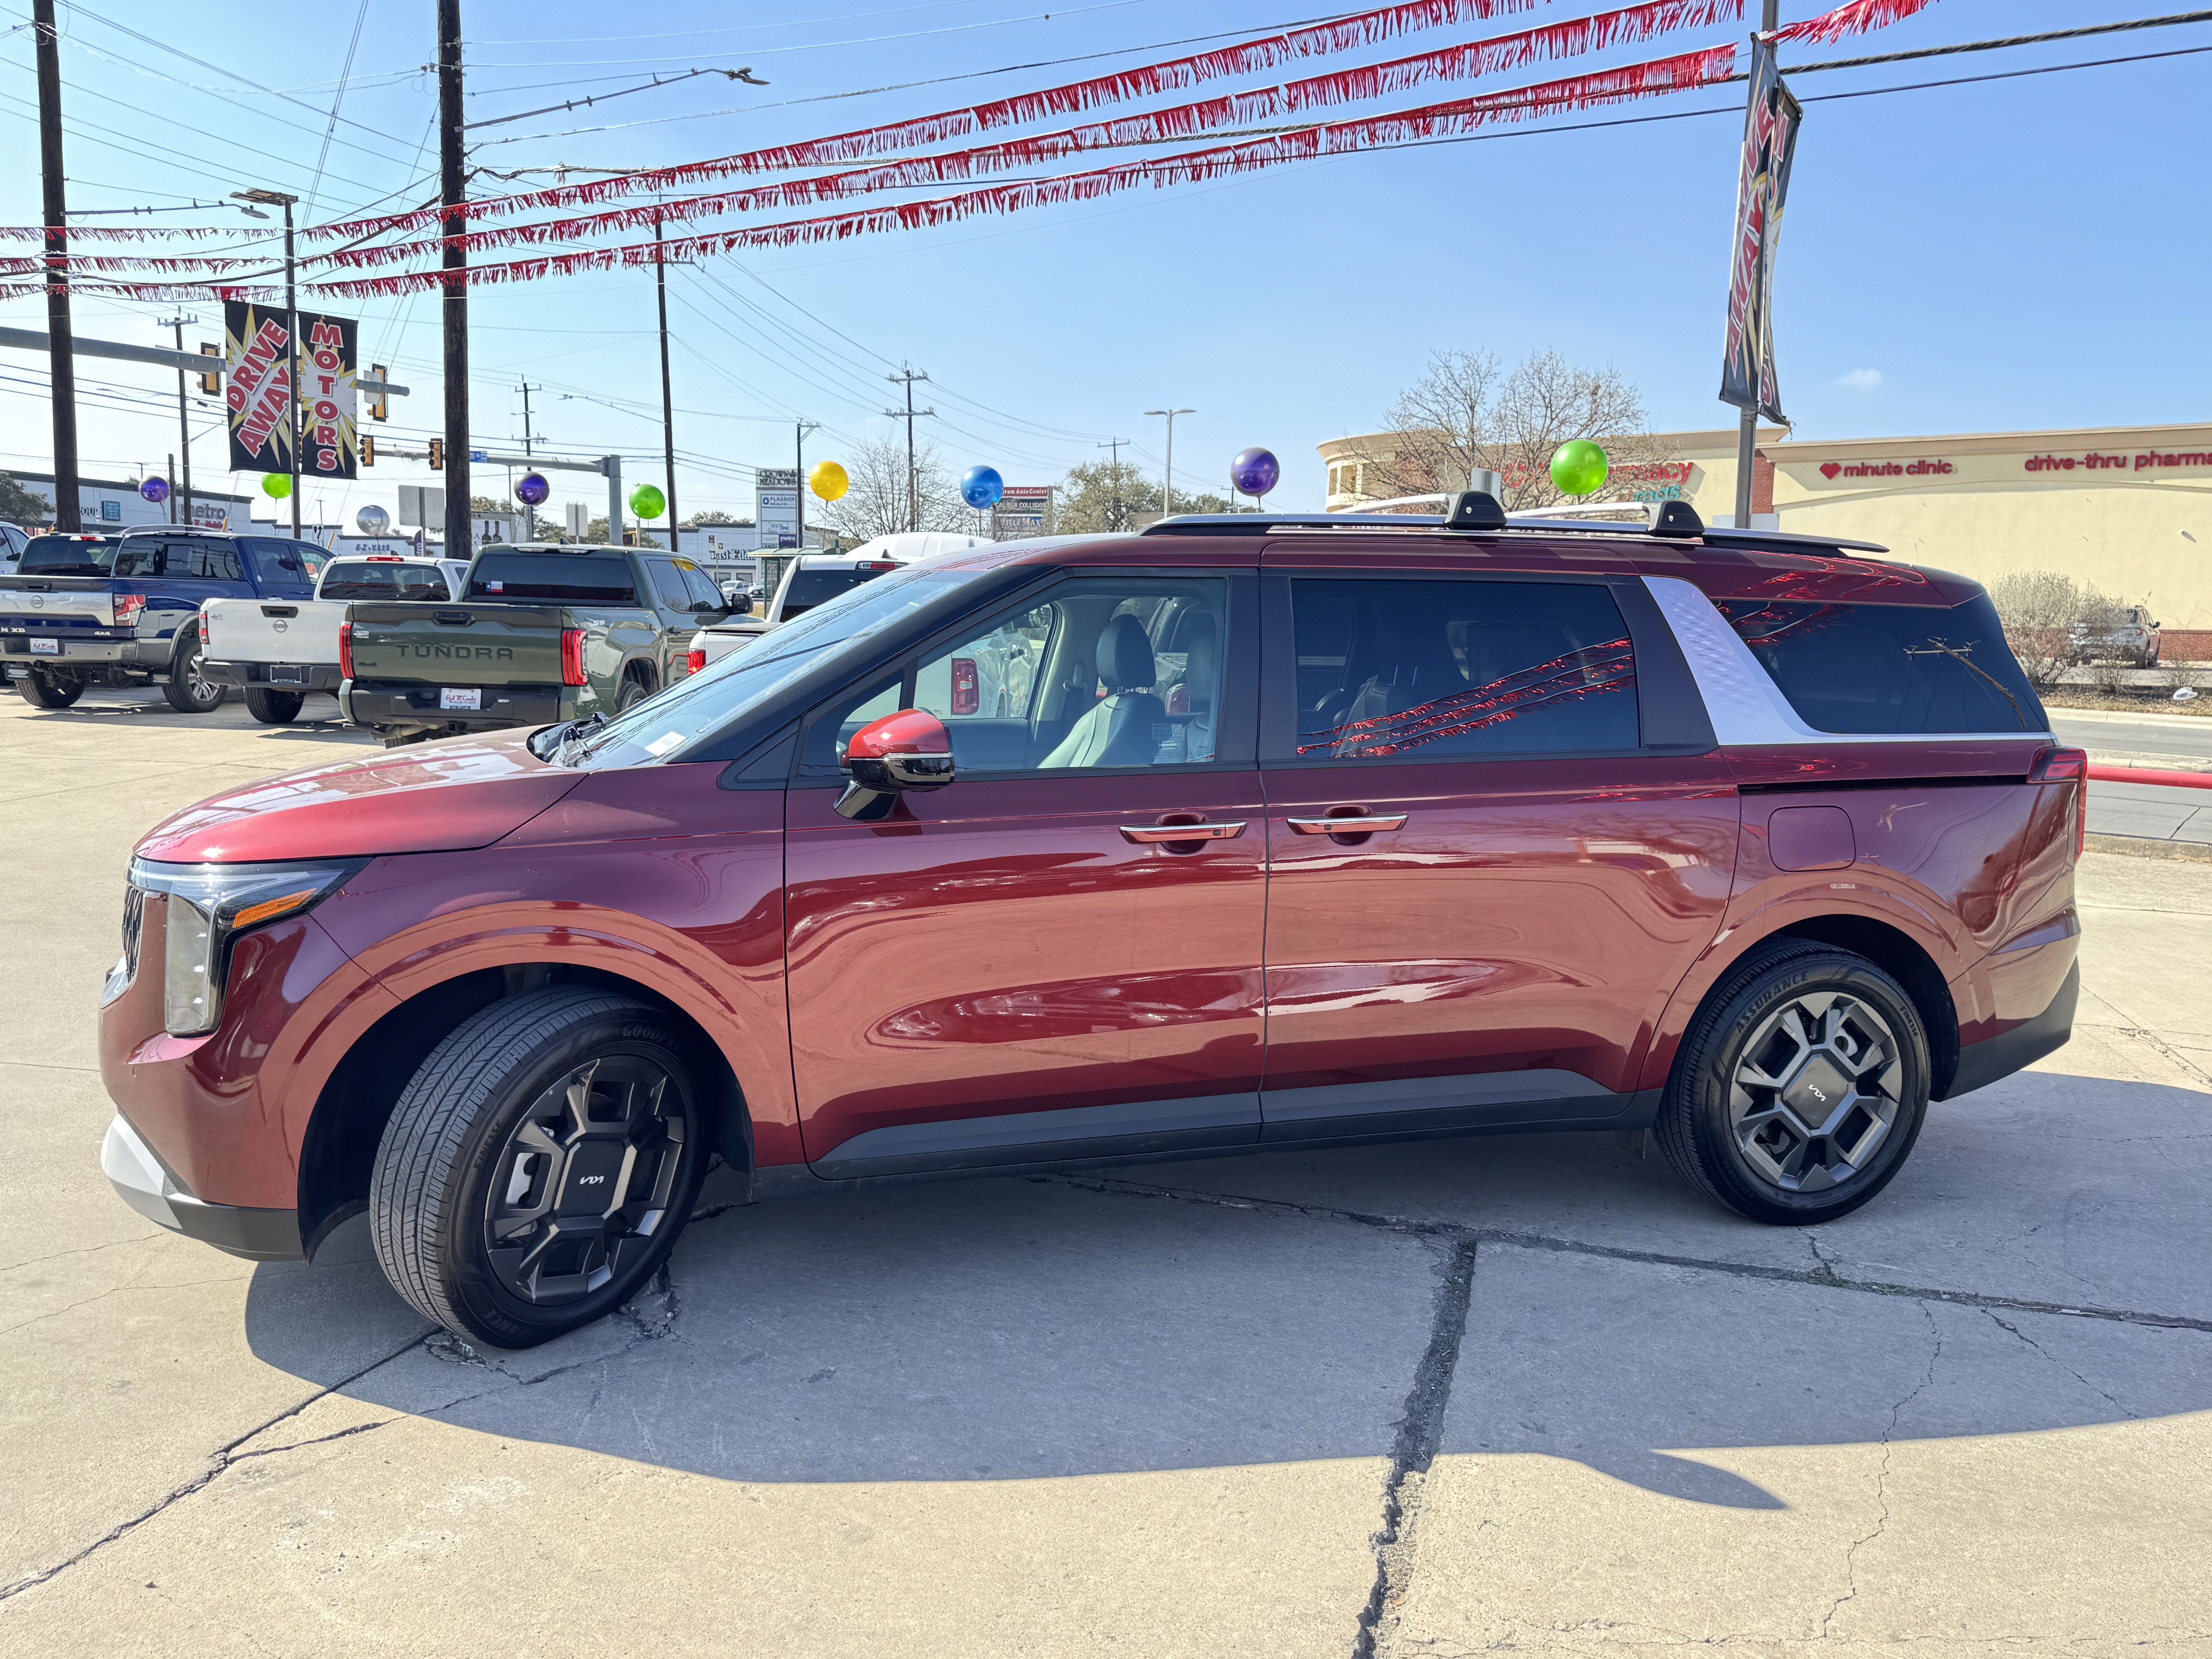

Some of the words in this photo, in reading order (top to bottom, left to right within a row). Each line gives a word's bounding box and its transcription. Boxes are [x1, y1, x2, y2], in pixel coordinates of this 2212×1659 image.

[227, 318, 289, 414] DRIVE
[236, 365, 290, 459] AWAY
[310, 322, 344, 471] MOTORS
[1844, 462, 1903, 477] minute
[1906, 460, 1953, 475] clinic
[2025, 453, 2127, 471] drive-thru
[2134, 450, 2212, 471] pharm
[393, 644, 514, 660] TUNDRA
[1736, 971, 1808, 1034] ASSURANCE
[1899, 1006, 1918, 1036] FINESSE
